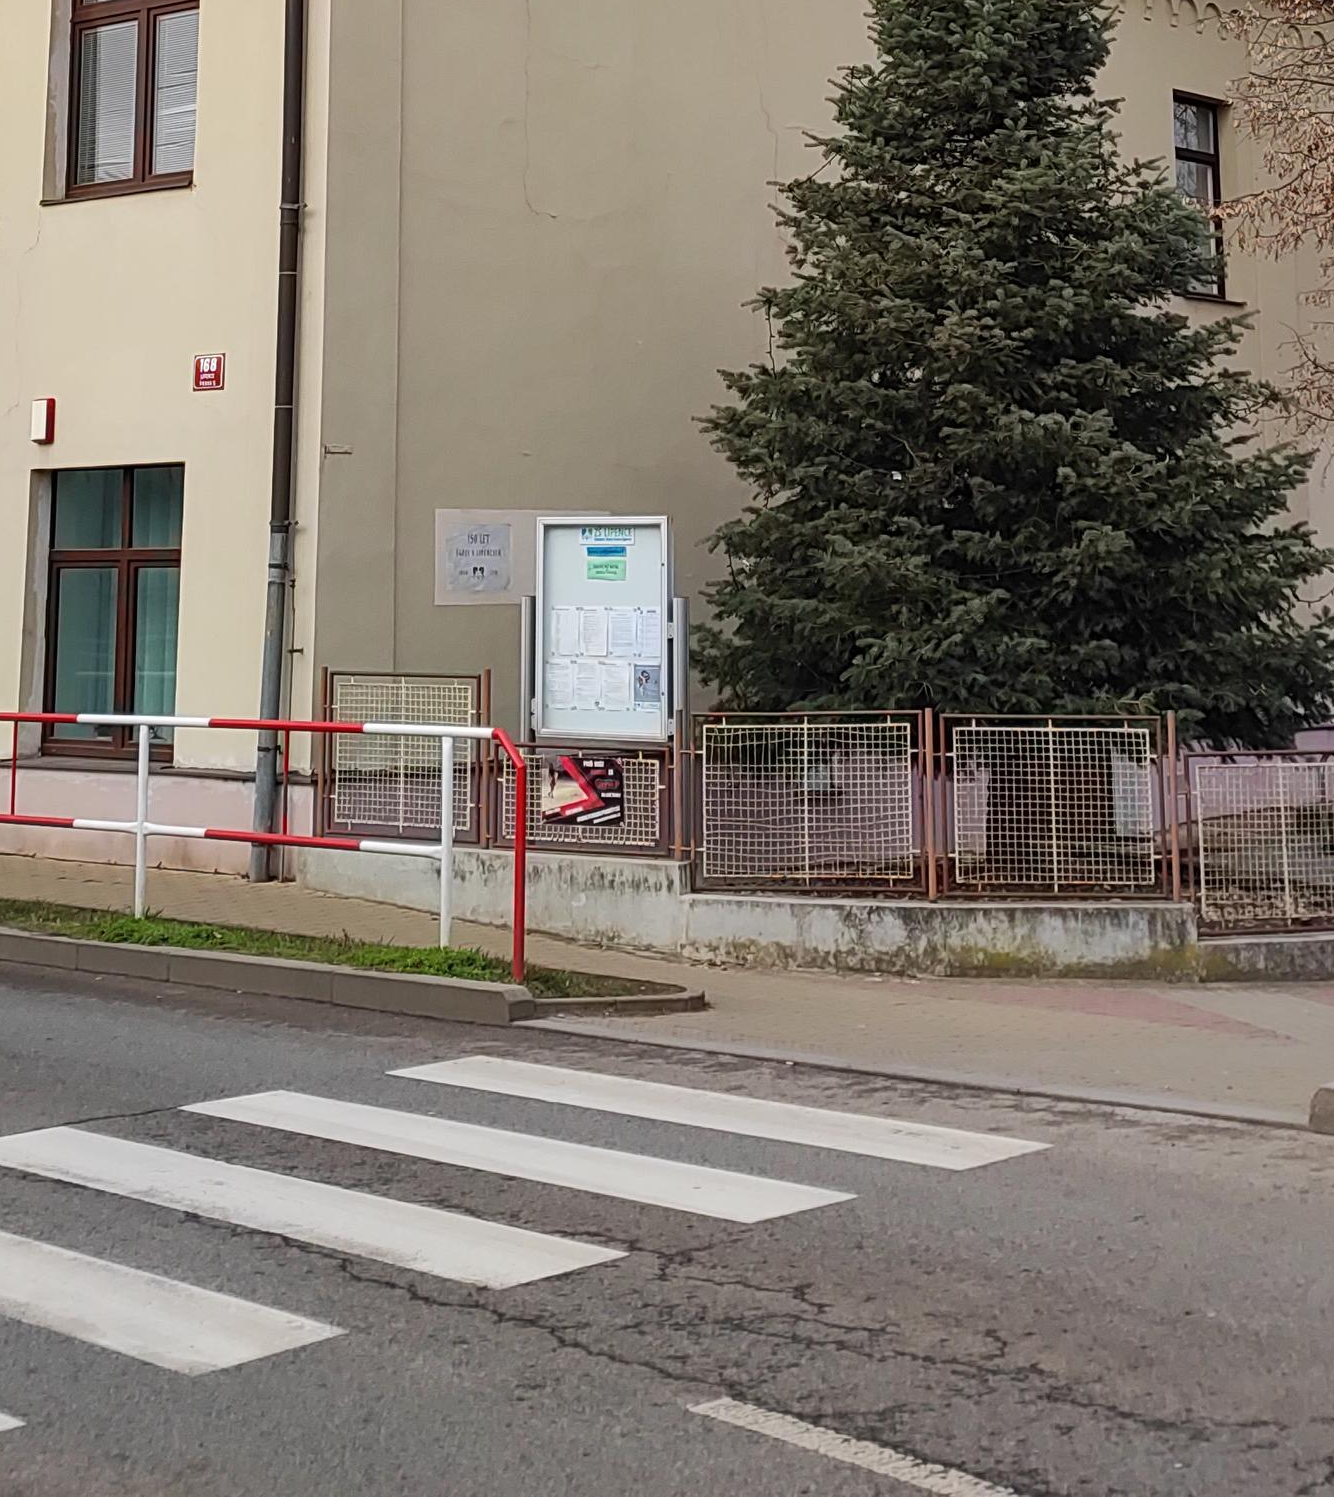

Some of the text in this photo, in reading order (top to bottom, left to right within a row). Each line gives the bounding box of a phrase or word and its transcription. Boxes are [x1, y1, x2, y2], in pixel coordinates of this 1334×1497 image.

[200, 358, 217, 373] 168
[467, 534, 491, 545] 150 LET
